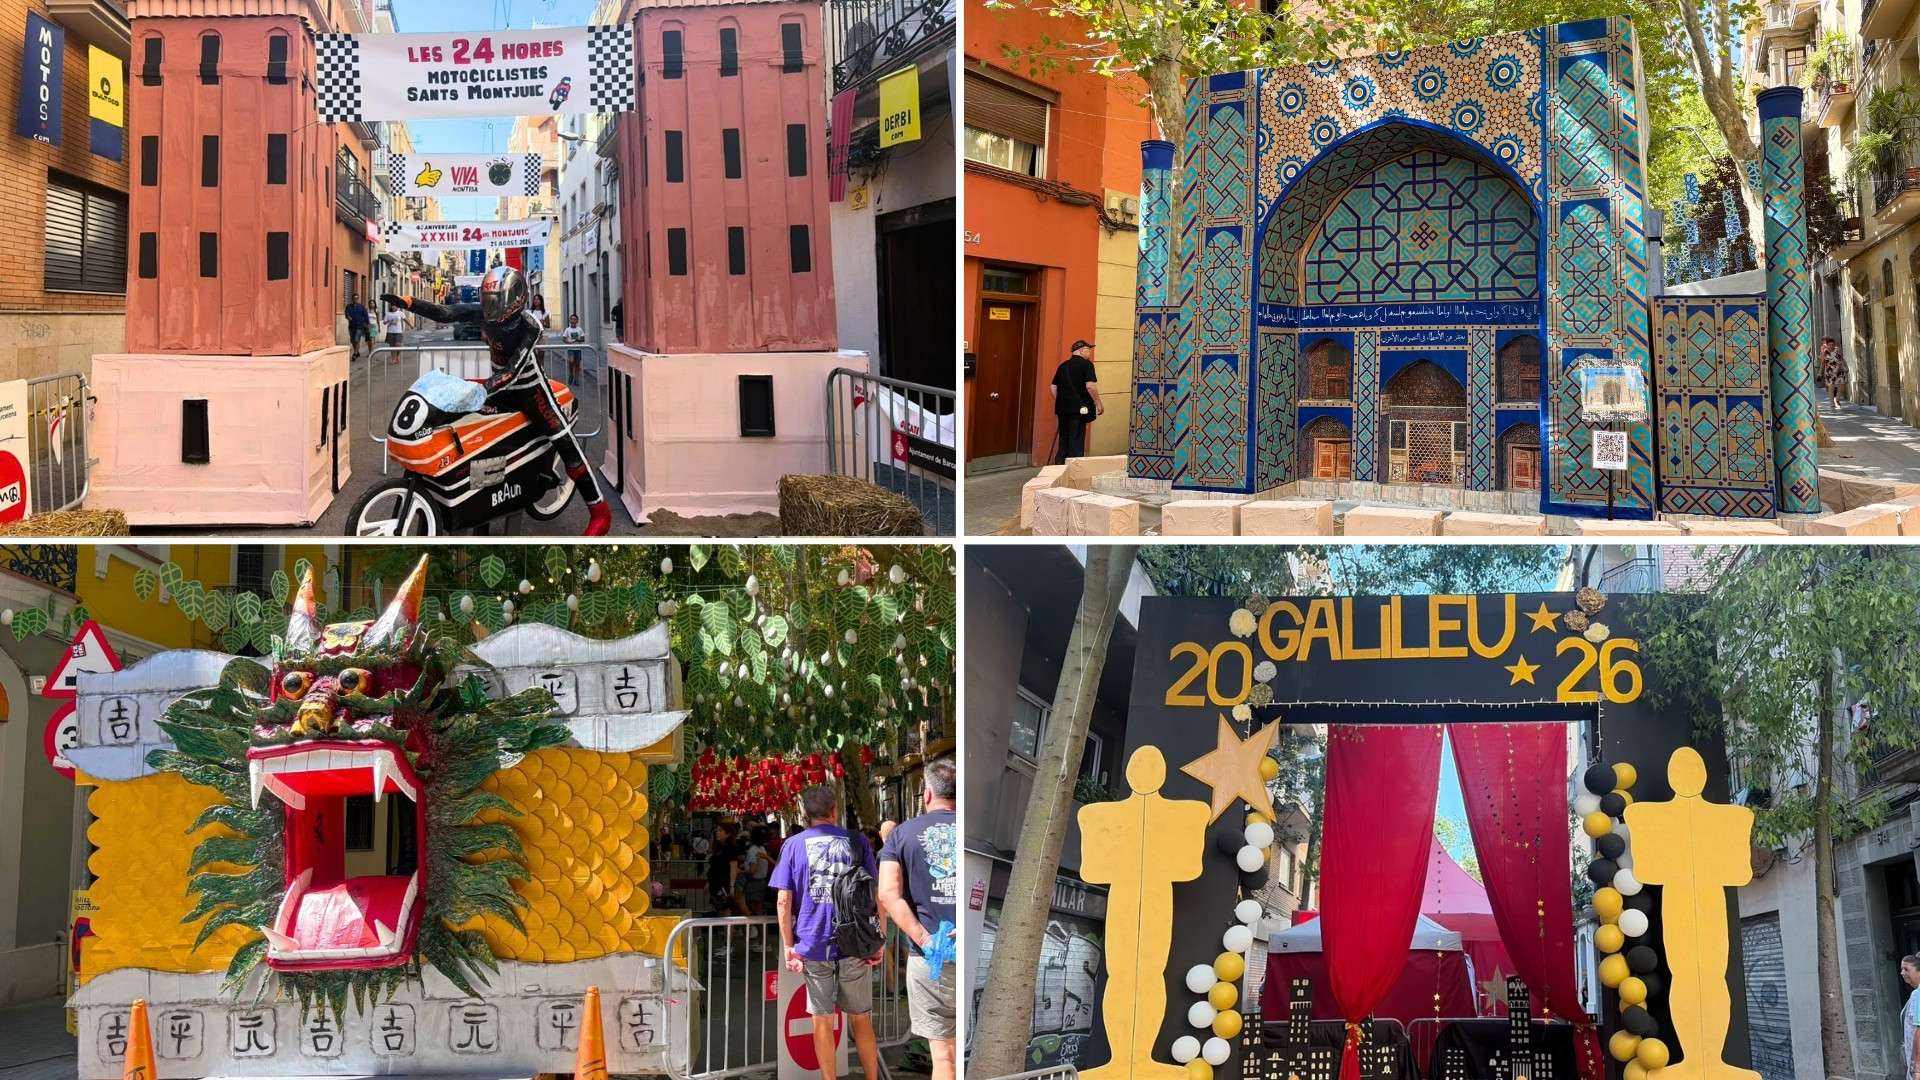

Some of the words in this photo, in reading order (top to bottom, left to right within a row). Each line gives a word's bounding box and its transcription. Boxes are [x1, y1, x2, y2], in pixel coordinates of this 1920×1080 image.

[407, 46, 443, 63] LES
[452, 37, 495, 65] 24
[502, 40, 564, 60] HORES
[428, 66, 548, 85] MOTOCICLISTES
[884, 109, 911, 132] DERBI
[450, 166, 479, 186] VIVA
[420, 232, 458, 242] XXXIII
[964, 230, 981, 245] 54
[397, 399, 420, 430] 8
[909, 446, 934, 462] Ajuntament
[935, 456, 942, 465] de
[1258, 594, 1516, 661] GALILEU
[1165, 641, 1252, 706] 20
[1556, 636, 1643, 704] 26
